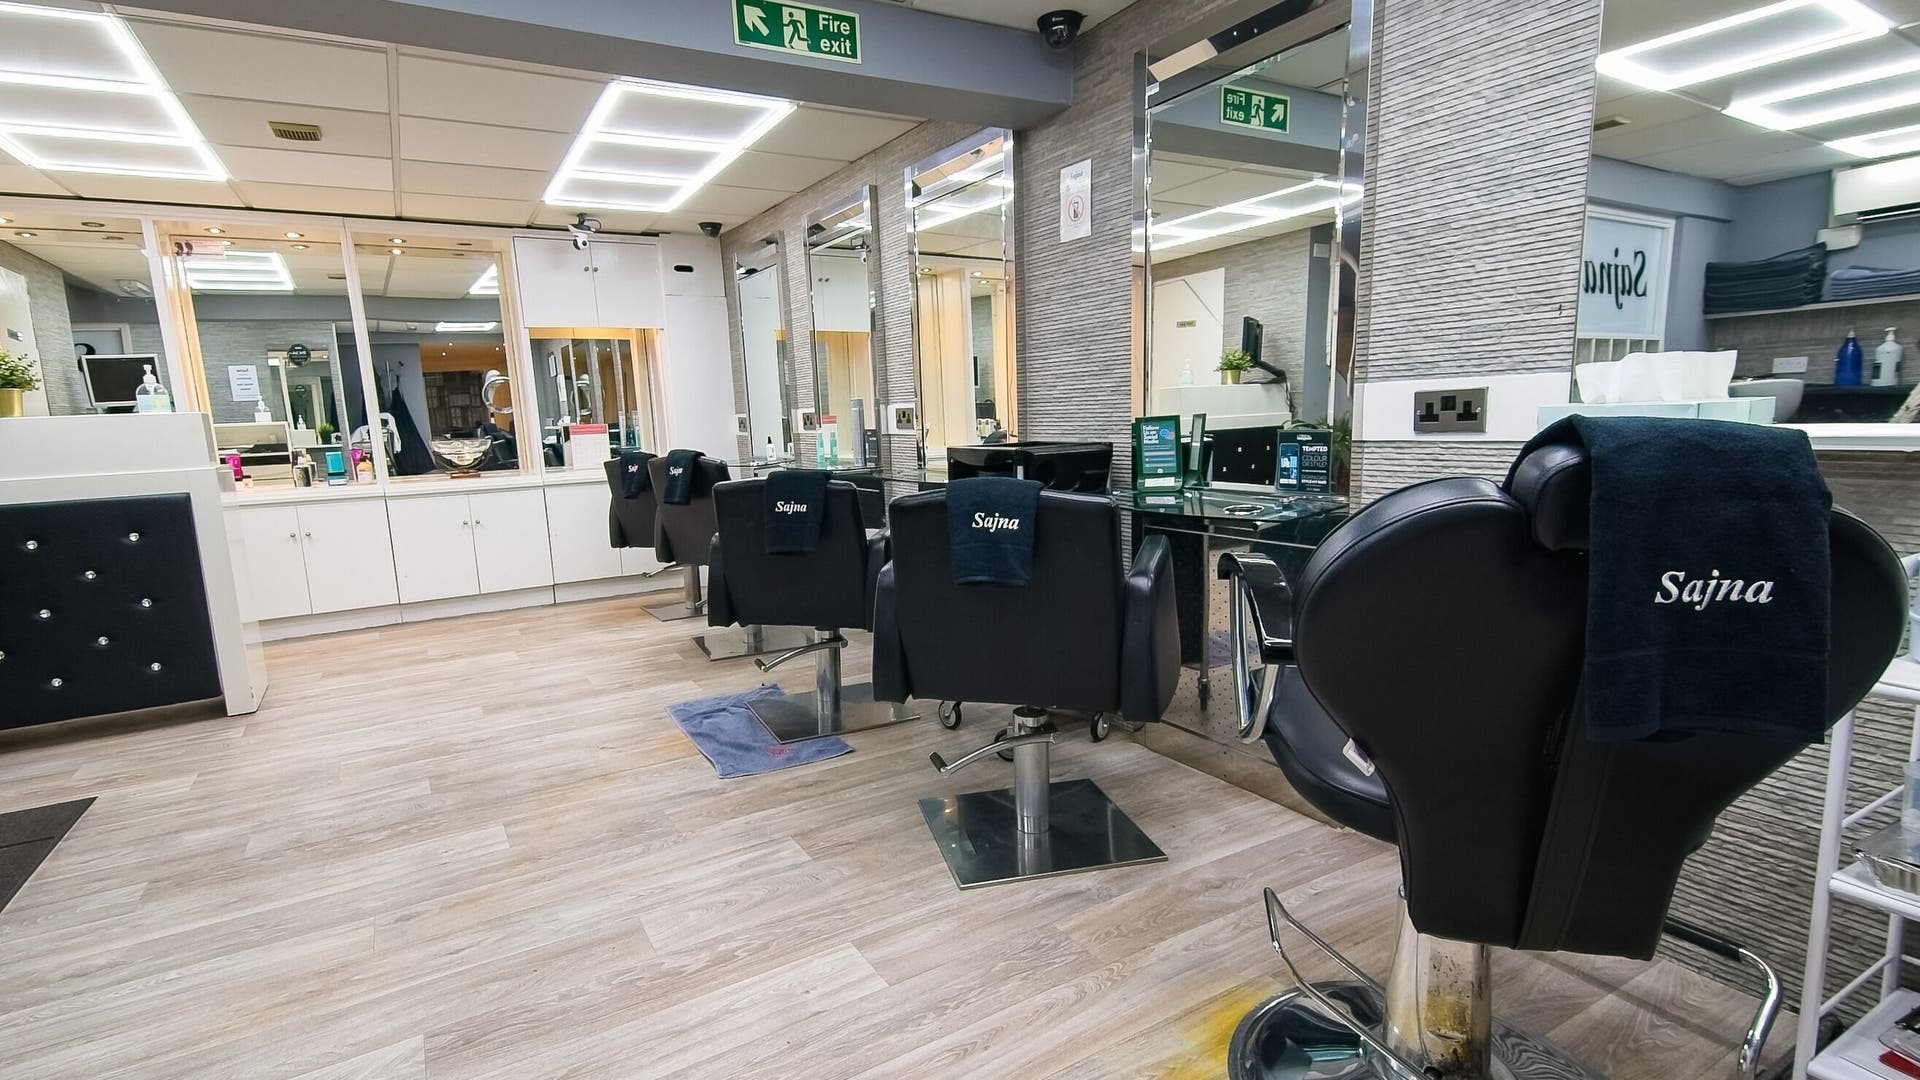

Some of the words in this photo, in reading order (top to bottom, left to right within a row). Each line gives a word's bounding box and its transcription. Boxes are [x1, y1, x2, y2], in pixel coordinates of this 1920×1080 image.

[819, 13, 851, 35] Fire
[820, 38, 852, 55] exit
[775, 500, 808, 515] Sajna
[971, 512, 1020, 532] Sajna
[1654, 569, 1775, 611] Sajna
